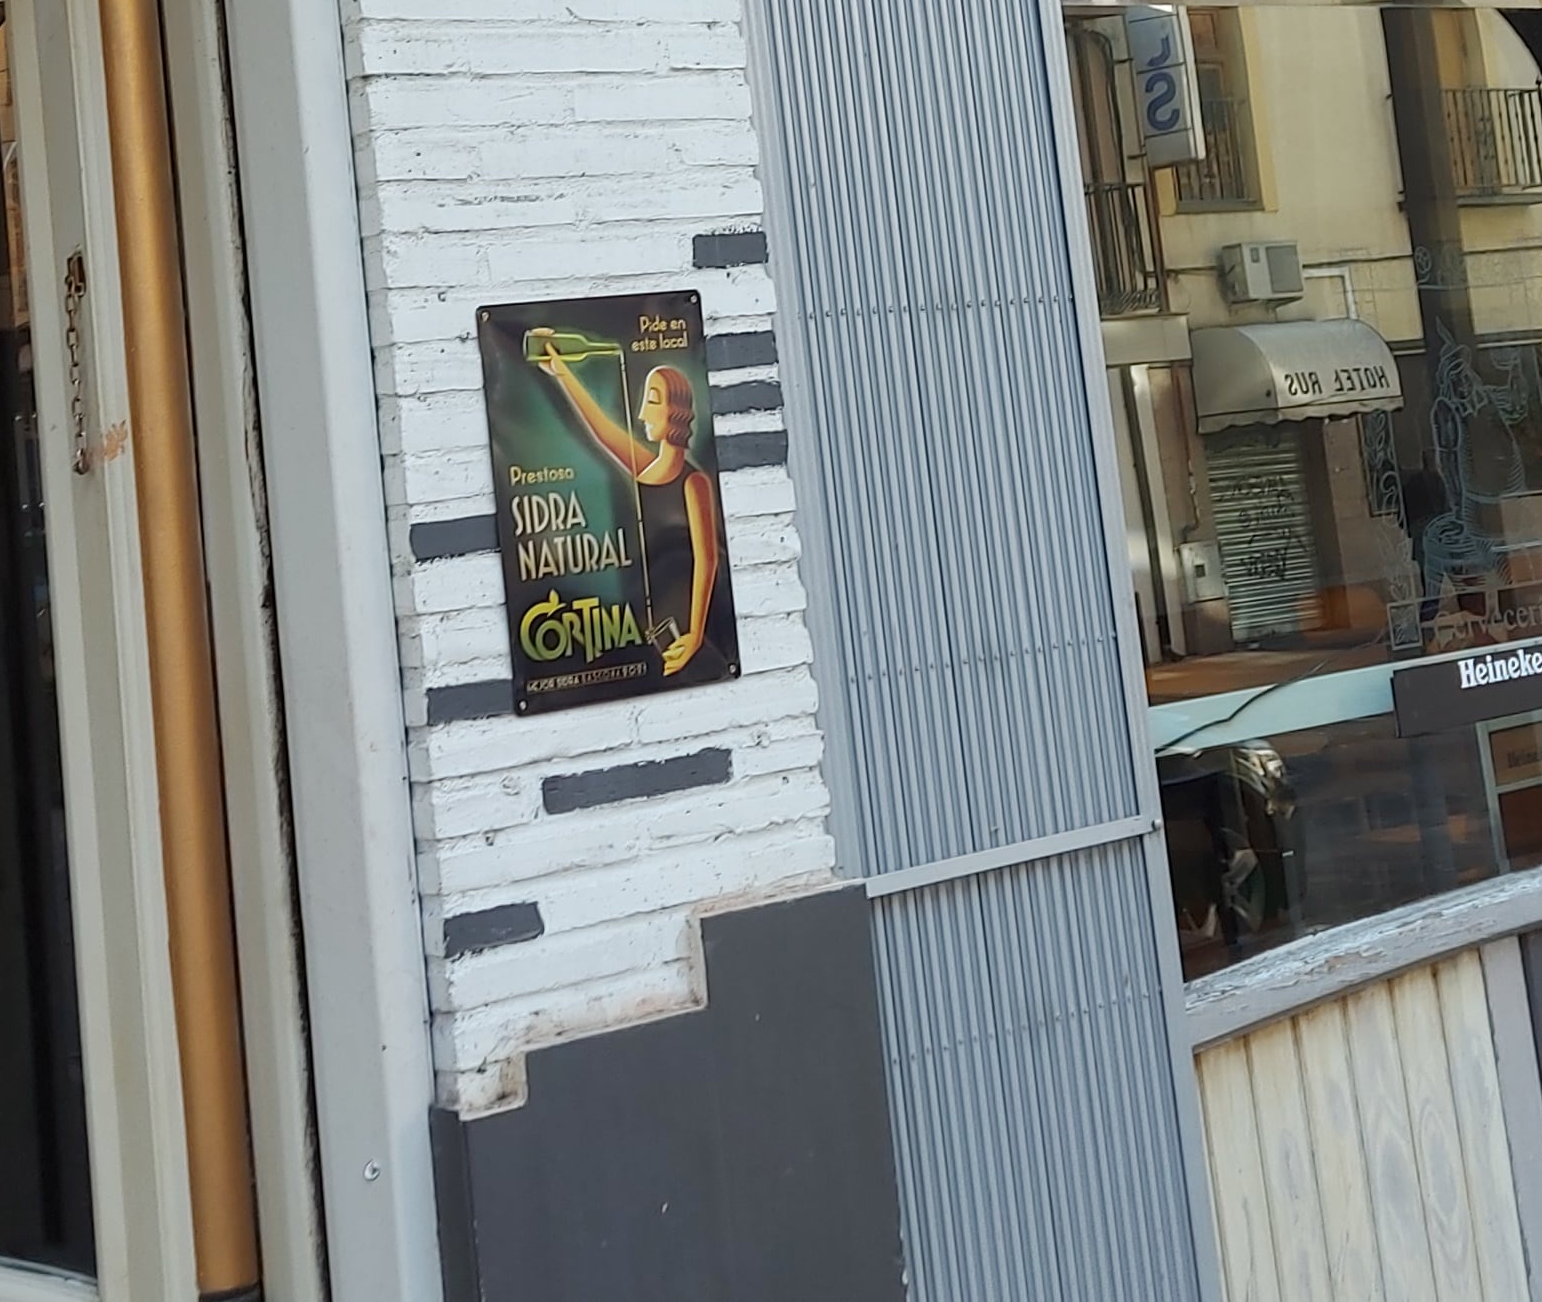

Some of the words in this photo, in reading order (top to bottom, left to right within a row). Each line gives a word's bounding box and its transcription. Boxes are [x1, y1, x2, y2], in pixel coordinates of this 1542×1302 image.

[639, 316, 668, 335] Pide
[670, 318, 687, 331] en
[631, 336, 659, 352] este
[659, 332, 689, 350] local
[510, 464, 575, 487] Prestosa
[510, 490, 588, 538] SIDRA
[517, 527, 634, 582] NATURAL
